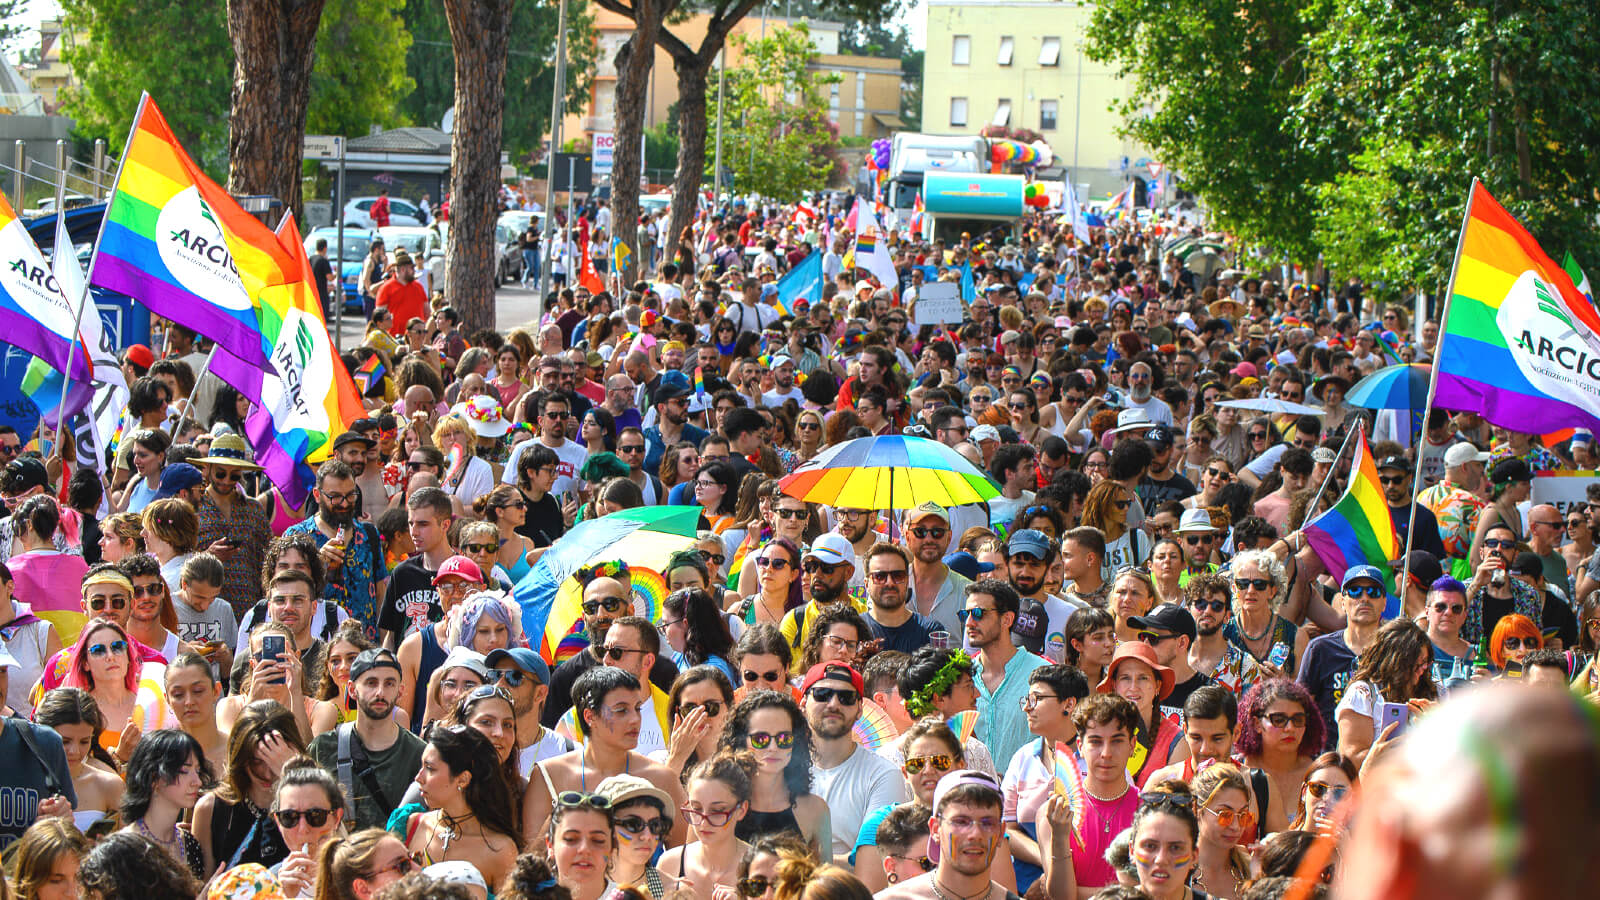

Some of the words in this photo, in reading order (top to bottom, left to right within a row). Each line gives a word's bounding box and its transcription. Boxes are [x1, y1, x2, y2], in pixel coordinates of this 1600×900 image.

[170, 228, 240, 278] ARCIG
[8, 258, 64, 298] ARC
[395, 589, 442, 613] GIUSEP
